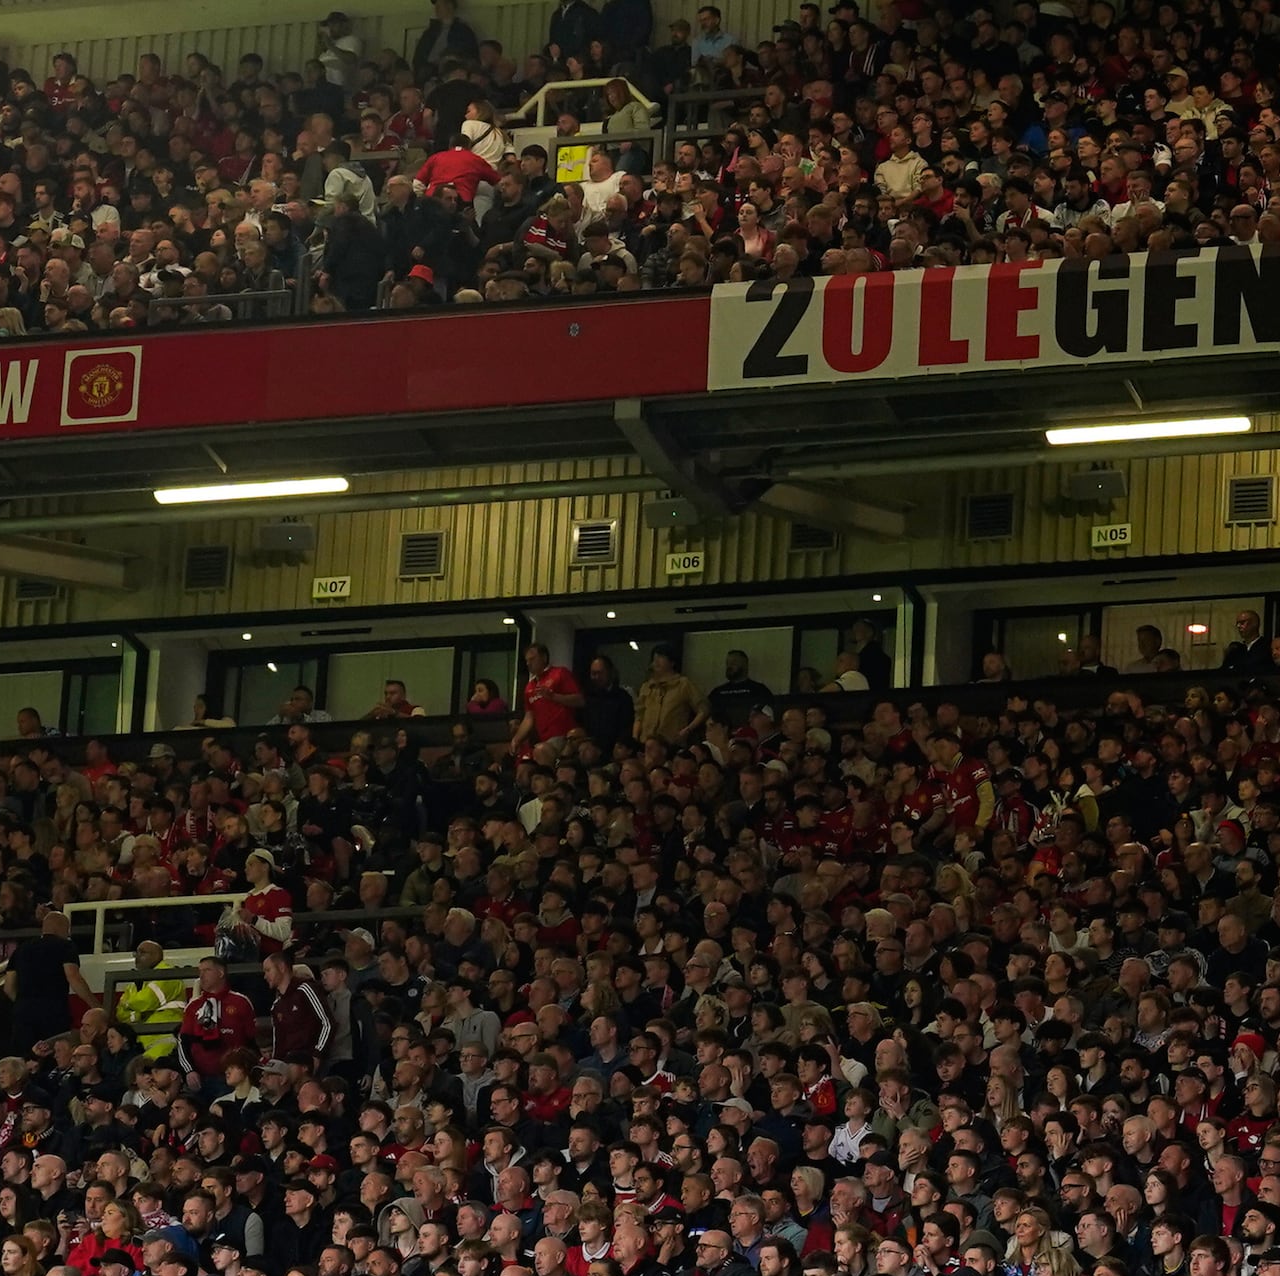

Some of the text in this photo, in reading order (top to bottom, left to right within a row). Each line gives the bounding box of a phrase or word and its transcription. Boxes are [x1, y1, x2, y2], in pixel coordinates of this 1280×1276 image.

[1096, 528, 1127, 542] N05
[671, 556, 700, 569] N06
[317, 581, 346, 593] N07
